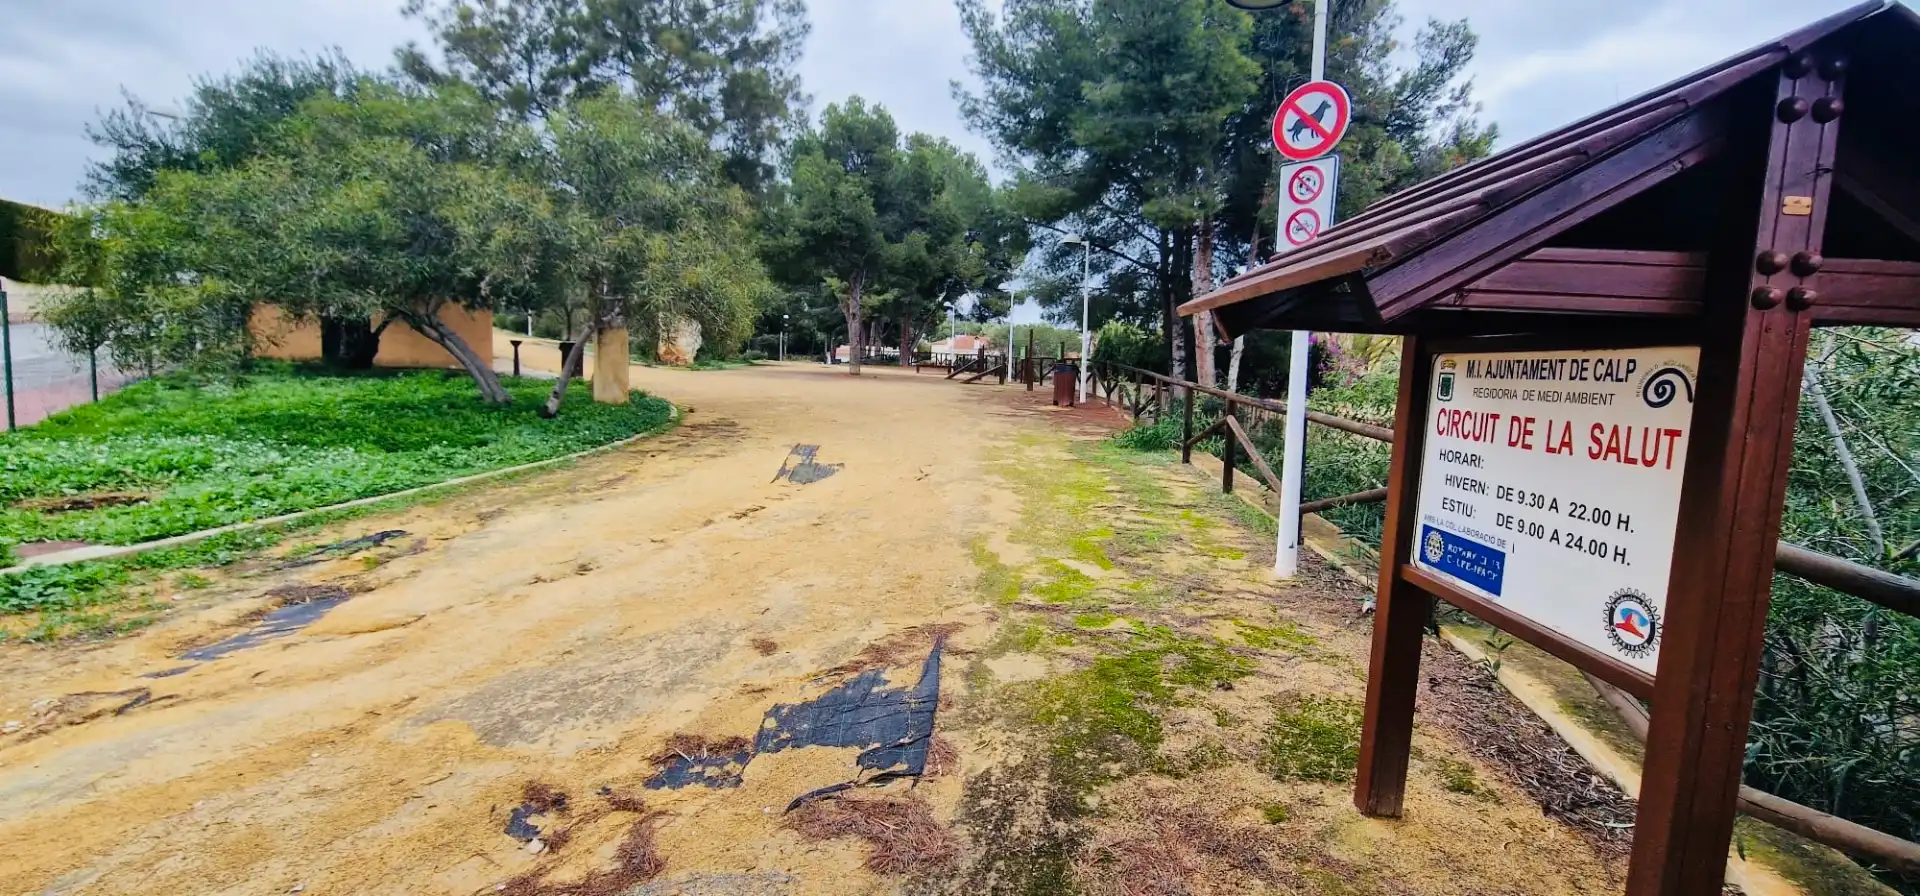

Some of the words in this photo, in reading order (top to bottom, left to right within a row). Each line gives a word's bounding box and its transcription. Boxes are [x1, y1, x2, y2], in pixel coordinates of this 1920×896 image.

[1466, 359, 1482, 379] M.I.
[1485, 358, 1566, 381] AJUNTAMENT
[1569, 358, 1590, 382] DE
[1593, 358, 1637, 383] CALP
[1473, 387, 1518, 400] REGIDORIA
[1522, 389, 1535, 402] DE
[1537, 390, 1562, 403] MEDI
[1564, 391, 1616, 406] AMBIENT
[1436, 407, 1501, 444] CIRCUIT
[1507, 415, 1536, 451] DE
[1545, 419, 1573, 456] LA
[1588, 422, 1682, 470] SALUT
[1439, 448, 1485, 469] HORARI:
[1445, 473, 1490, 497] HIVERN:
[1496, 485, 1514, 502] DE
[1517, 490, 1545, 510] 9.30
[1548, 497, 1559, 514] A
[1568, 501, 1612, 527] 22.00
[1617, 513, 1634, 534] H.
[1442, 497, 1477, 519] ESTIU:
[1496, 512, 1514, 531] DE
[1517, 519, 1545, 540] 9.00
[1549, 528, 1560, 545] A
[1565, 532, 1608, 559] 24.00
[1613, 545, 1631, 567] H.
